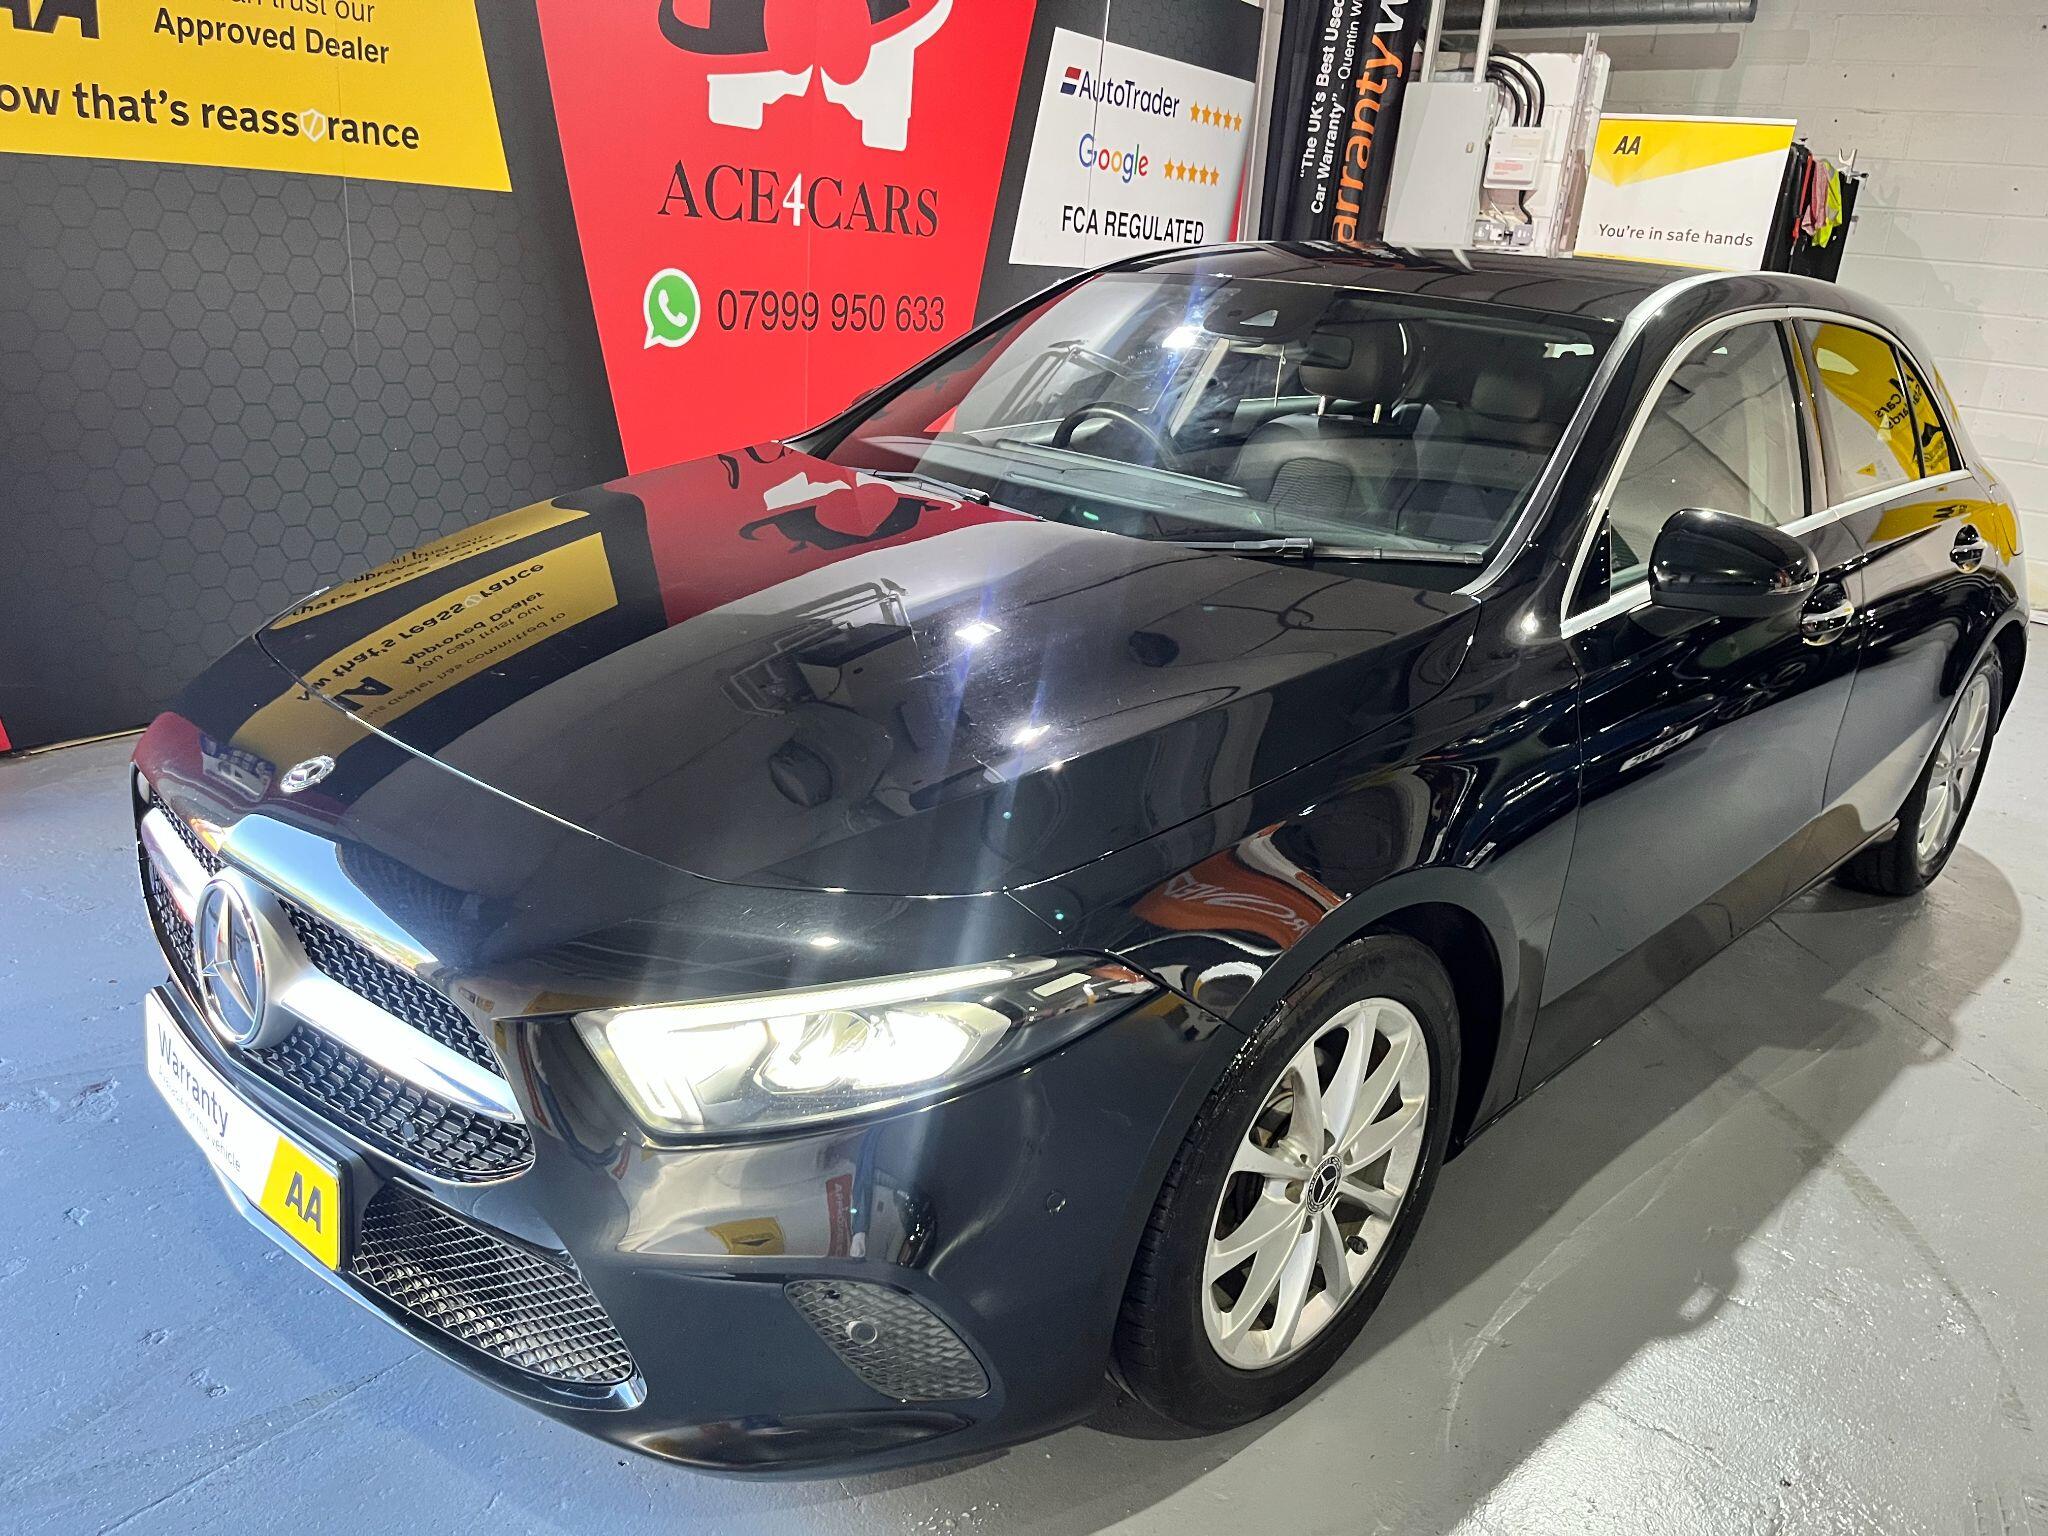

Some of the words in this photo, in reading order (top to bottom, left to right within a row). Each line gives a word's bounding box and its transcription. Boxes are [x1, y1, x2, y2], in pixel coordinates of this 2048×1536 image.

[335, 0, 375, 23] our
[154, 7, 296, 51] Approved
[305, 27, 390, 65] Dealer
[1315, 45, 1336, 87] Best
[72, 81, 190, 127] that's
[1078, 71, 1180, 118] AutoTrader
[1310, 183, 1327, 214] Car
[1337, 21, 1360, 80] Quentin
[1078, 133, 1149, 183] Google
[1612, 135, 1642, 156] AA
[657, 160, 938, 238] ACE4CARS
[1061, 204, 1099, 235] FCA
[1104, 209, 1205, 244] REGULATED
[1598, 222, 1646, 240] You're
[1648, 225, 1663, 241] in
[1666, 226, 1701, 244] safe
[1704, 229, 1754, 248] hands
[717, 289, 820, 331] 07999
[831, 292, 886, 332] 950
[895, 295, 945, 333] 633
[157, 1022, 229, 1138] Warranty
[284, 1170, 322, 1235] AA
